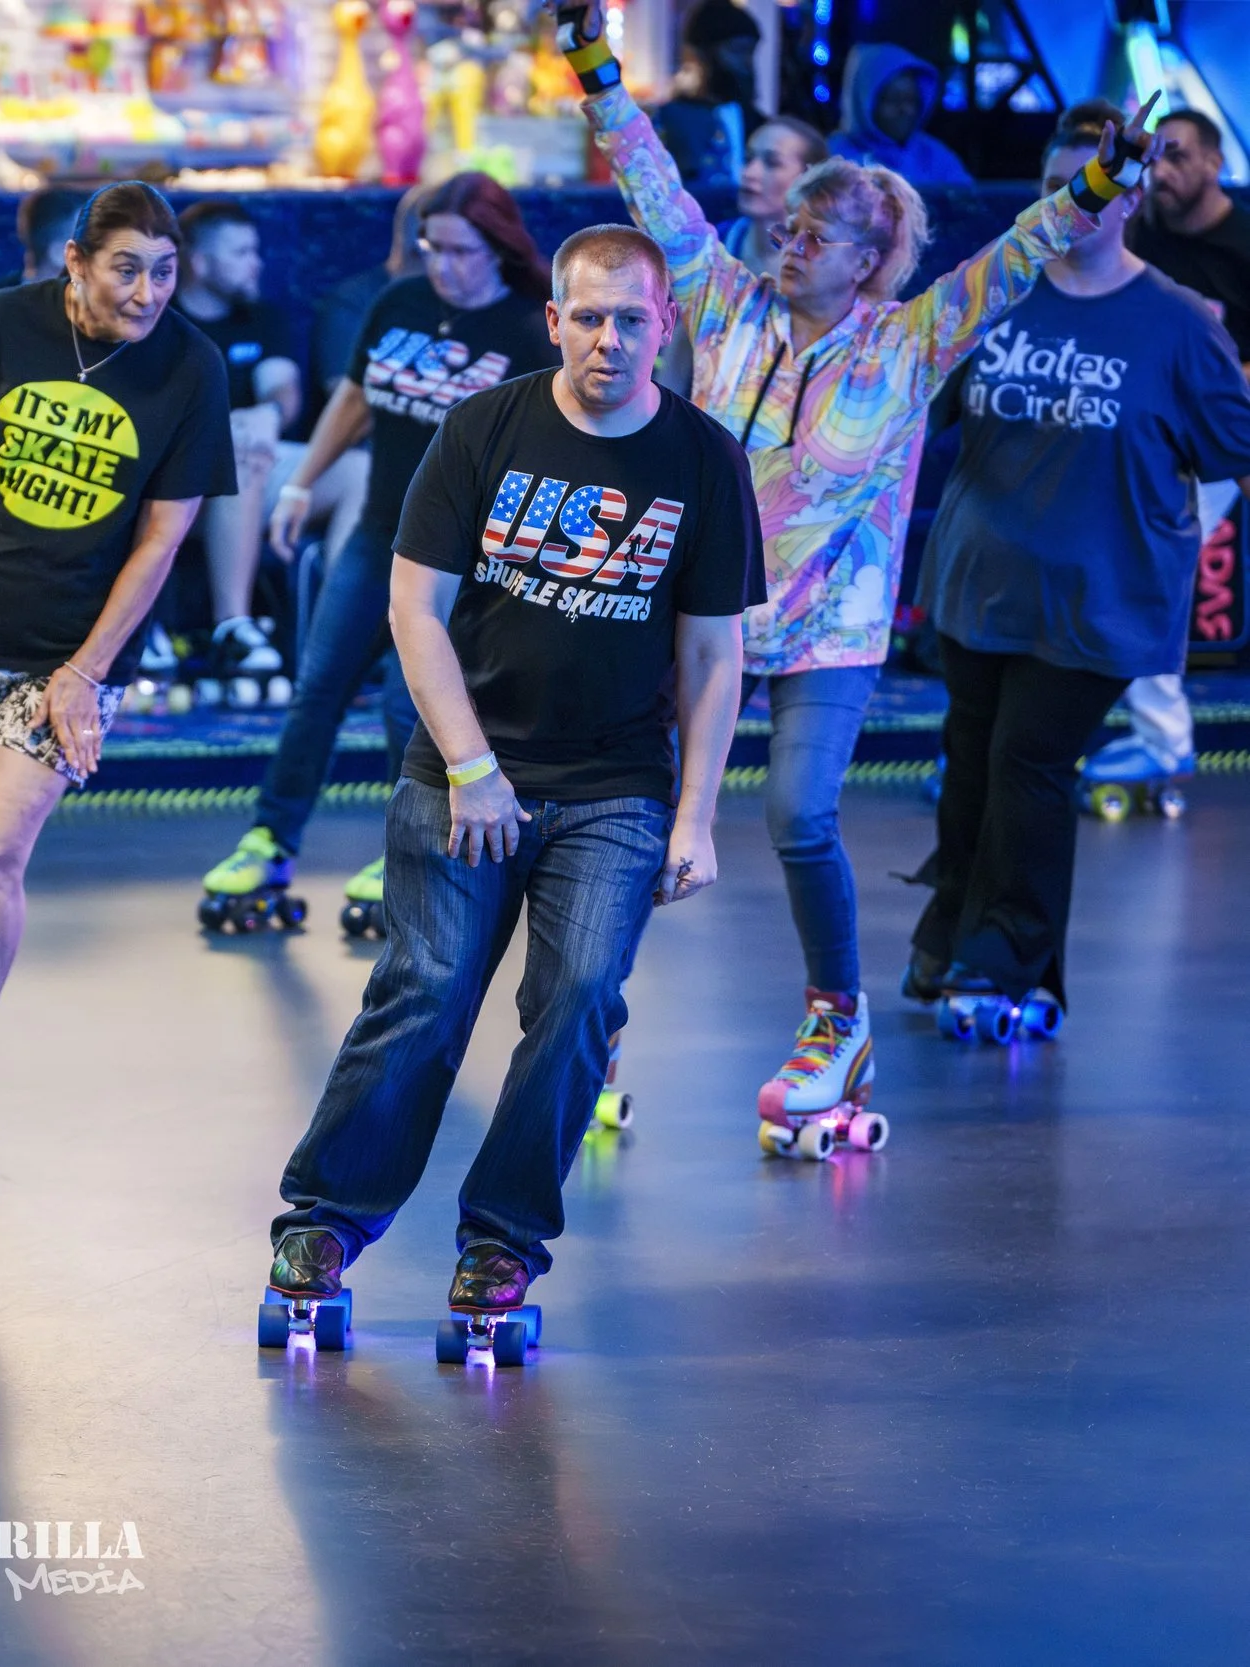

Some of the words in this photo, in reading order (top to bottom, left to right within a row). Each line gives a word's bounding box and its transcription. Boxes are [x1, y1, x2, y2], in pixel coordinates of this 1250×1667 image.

[366, 327, 511, 406] USA
[979, 319, 1128, 391] Skates
[13, 388, 68, 426] IT'S
[72, 407, 126, 441] MY
[991, 383, 1122, 430] Circles
[481, 470, 685, 591] USA
[474, 555, 560, 607] SHUFFLE
[556, 586, 651, 622] SKATERS
